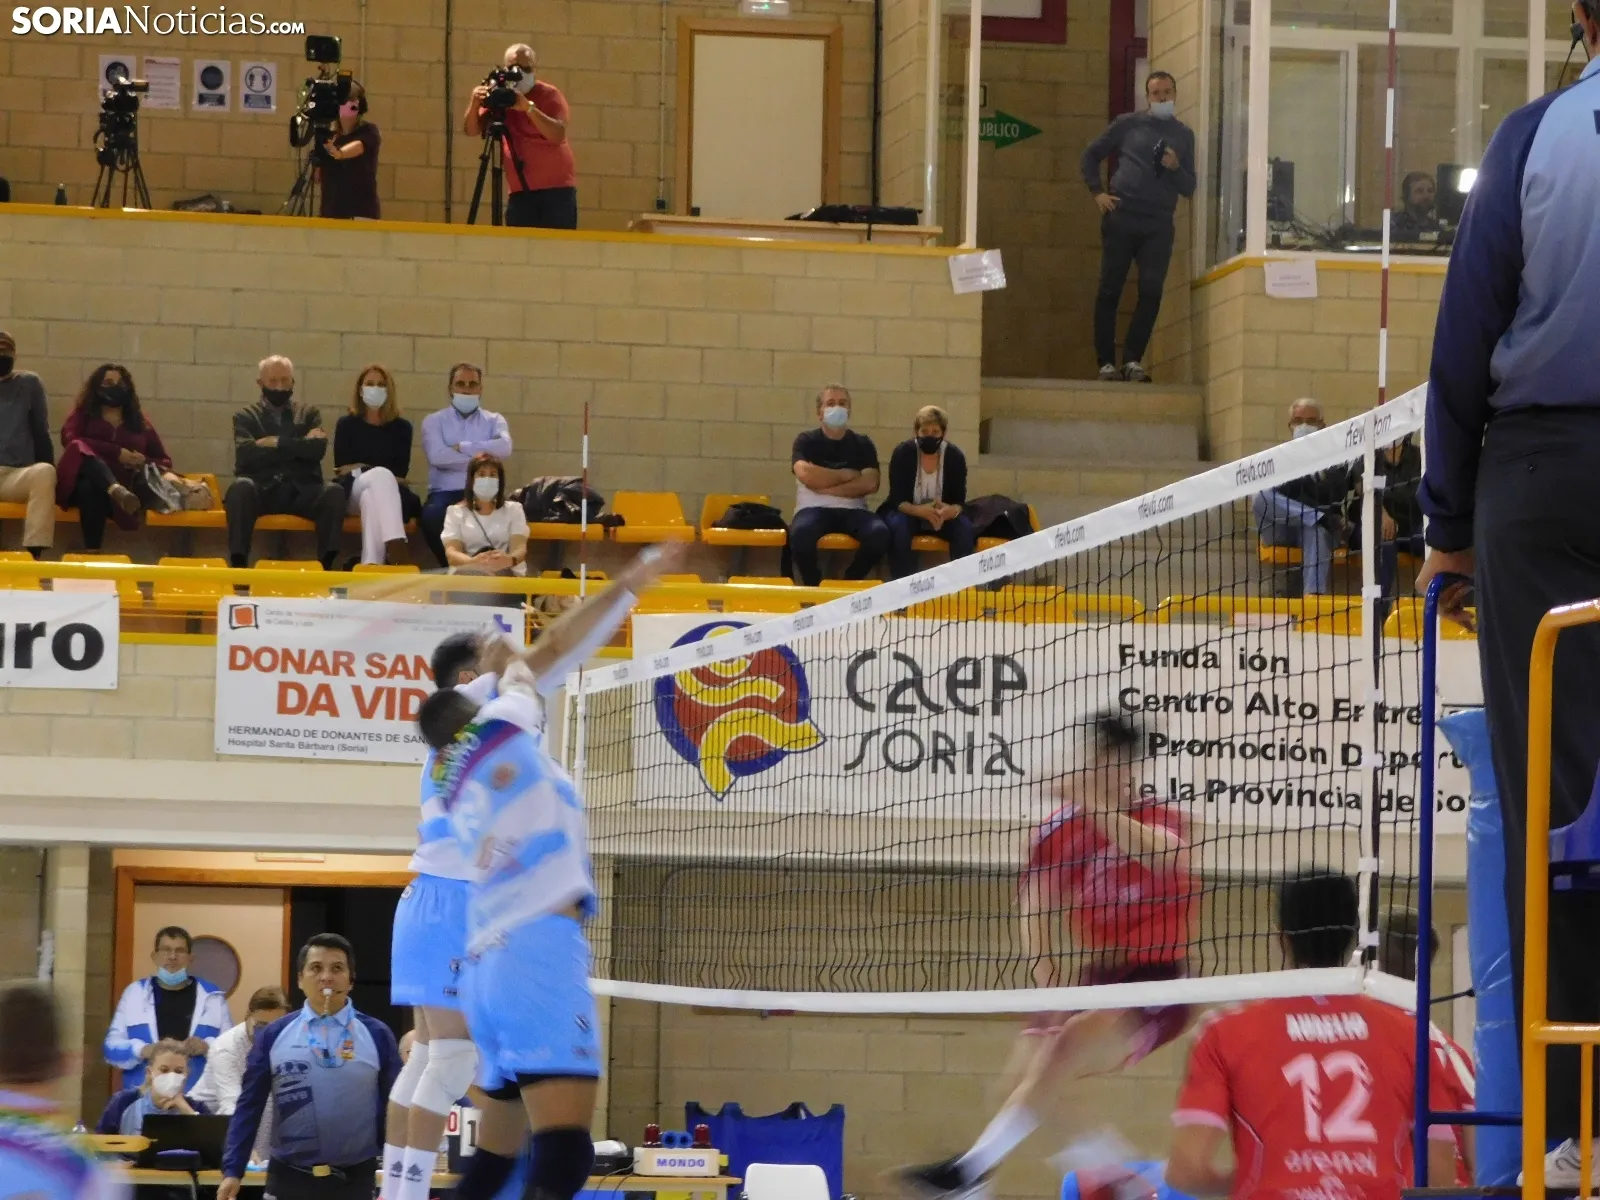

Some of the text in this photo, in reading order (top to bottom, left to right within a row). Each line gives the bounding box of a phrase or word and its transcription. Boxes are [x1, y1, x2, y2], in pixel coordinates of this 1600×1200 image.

[979, 122, 1019, 138] UBLICO
[1235, 457, 1275, 486] rfevb.com
[1137, 493, 1174, 521] rfevb.com
[1054, 524, 1085, 549] rfevb.com
[0, 621, 105, 671] ro
[228, 645, 435, 682] DONAR SAN
[276, 680, 430, 722] DA VID
[1118, 687, 1233, 714] Centro
[1245, 691, 1319, 720] Alto
[227, 737, 369, 754] Hospital Santa Bárbara (Soria)
[228, 725, 430, 745] HERMANDAD DE DONANTES DE SAN
[1148, 731, 1327, 766] Promoción
[1170, 777, 1196, 801] la
[1206, 779, 1363, 810] Provincia
[1379, 788, 1415, 812] de
[1281, 1050, 1378, 1143] 12
[656, 1158, 705, 1168] MONDO
